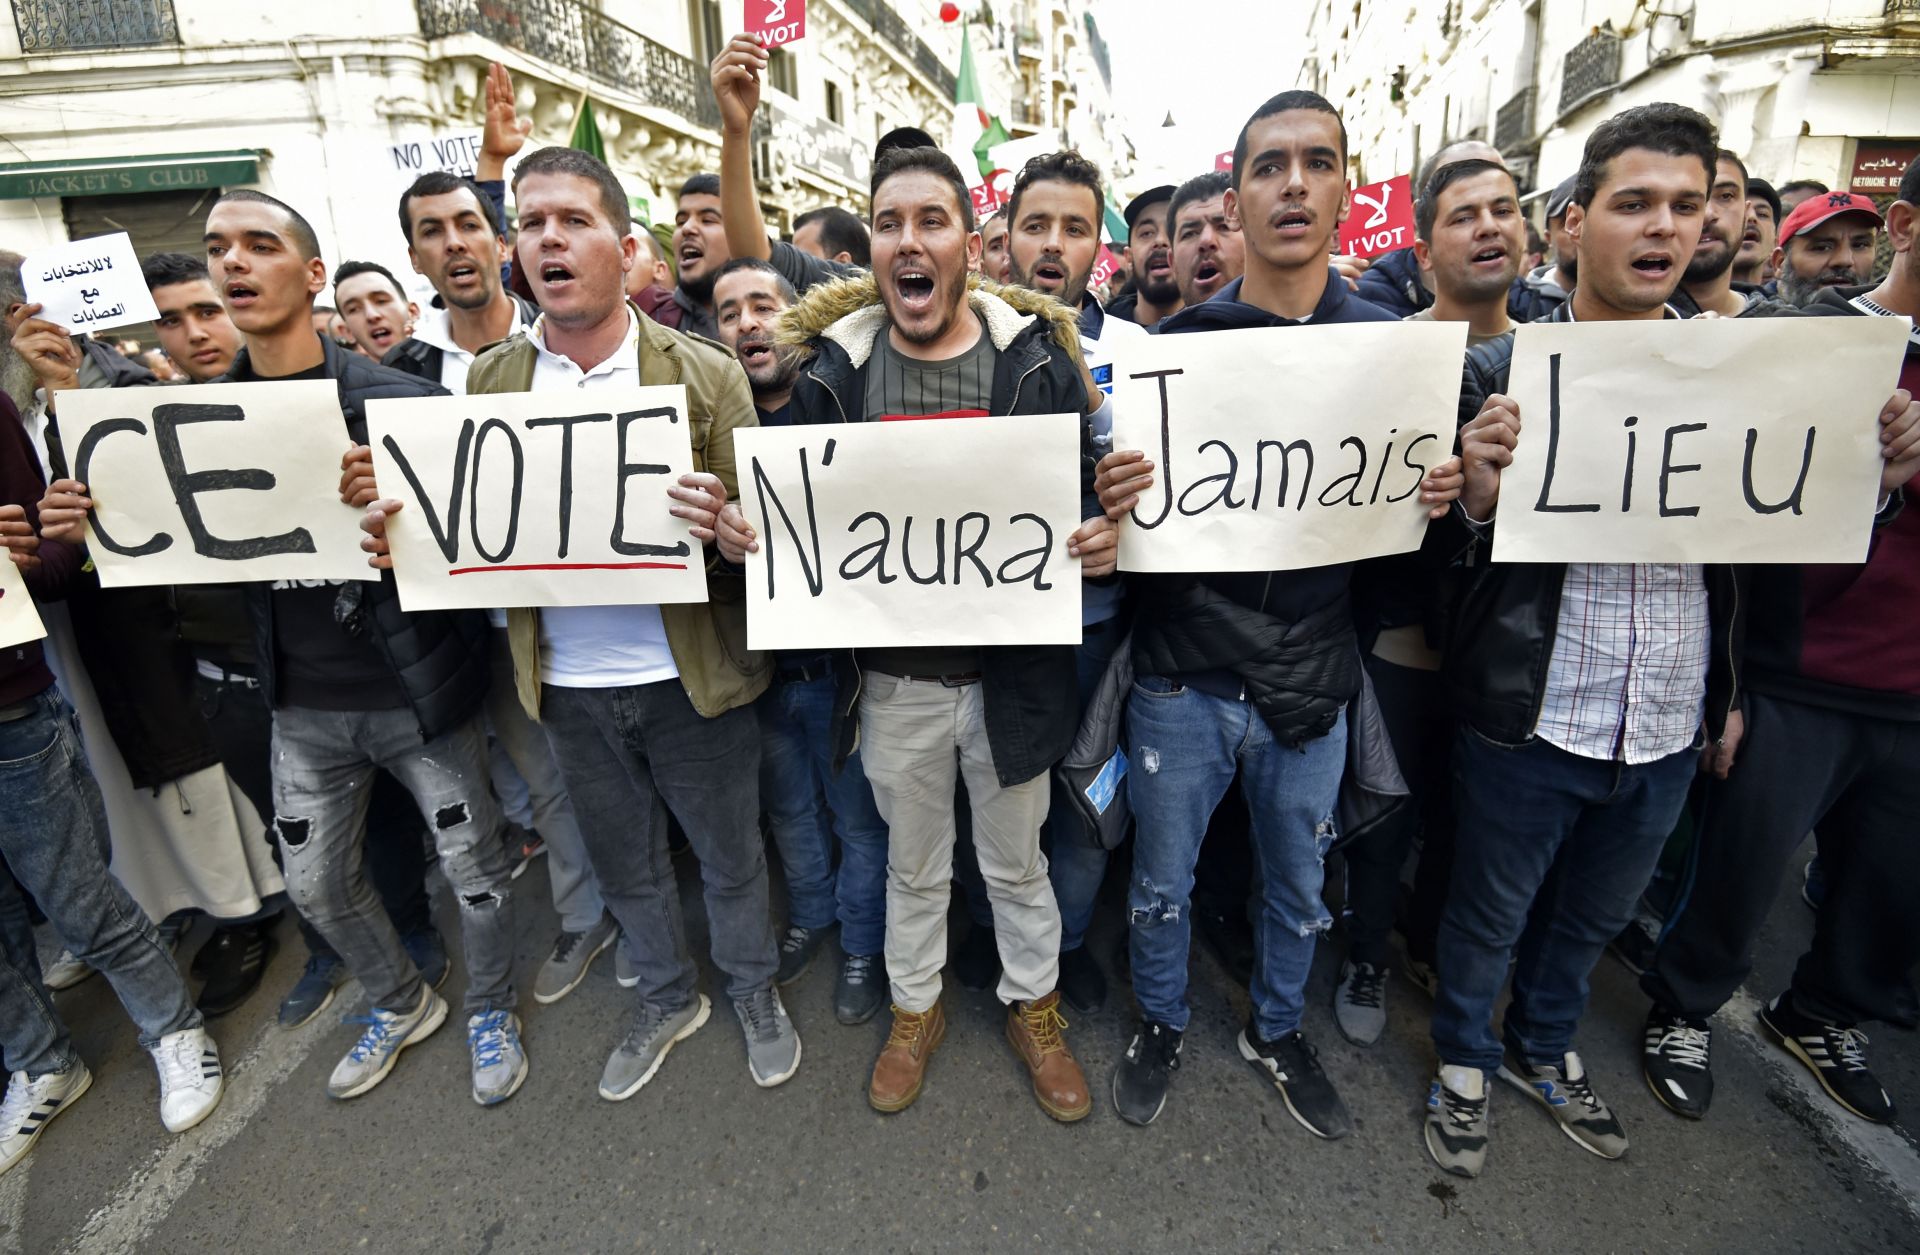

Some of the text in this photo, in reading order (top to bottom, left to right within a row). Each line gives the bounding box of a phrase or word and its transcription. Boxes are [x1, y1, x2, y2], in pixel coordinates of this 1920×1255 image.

[393, 142, 422, 170] NO
[28, 168, 208, 195] JACKET'S CLUB
[1852, 176, 1886, 187] RETOUCHE
[80, 287, 100, 304] مع
[72, 302, 126, 325] العصابات
[1129, 368, 1438, 531] Jamais
[75, 403, 317, 560] CE
[382, 406, 691, 563] VOTE
